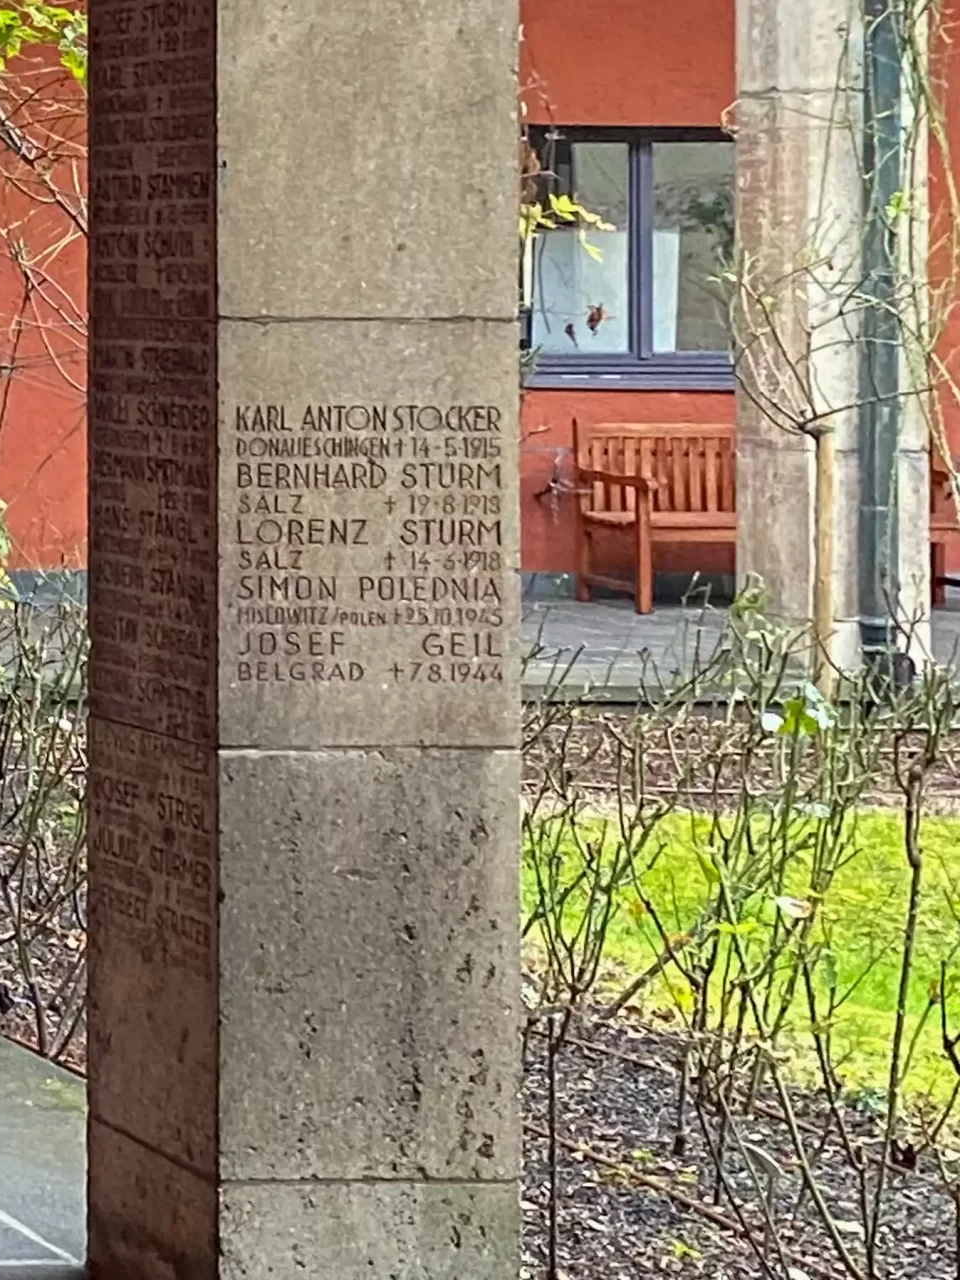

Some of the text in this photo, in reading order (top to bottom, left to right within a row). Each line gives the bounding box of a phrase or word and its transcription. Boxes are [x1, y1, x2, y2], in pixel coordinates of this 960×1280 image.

[236, 405, 501, 432] KARL ANTON STOCKER
[236, 437, 390, 458] DONAUESCHINGEN
[236, 463, 502, 489] BERNHARD STURM
[238, 494, 303, 515] SALZ
[237, 519, 502, 546] LORENZ STURM
[238, 550, 303, 570] SALZ
[237, 576, 502, 602] SIMON POLEDNIA
[239, 632, 502, 657] JOSEF GEIL
[238, 662, 364, 682] BELGRAD
